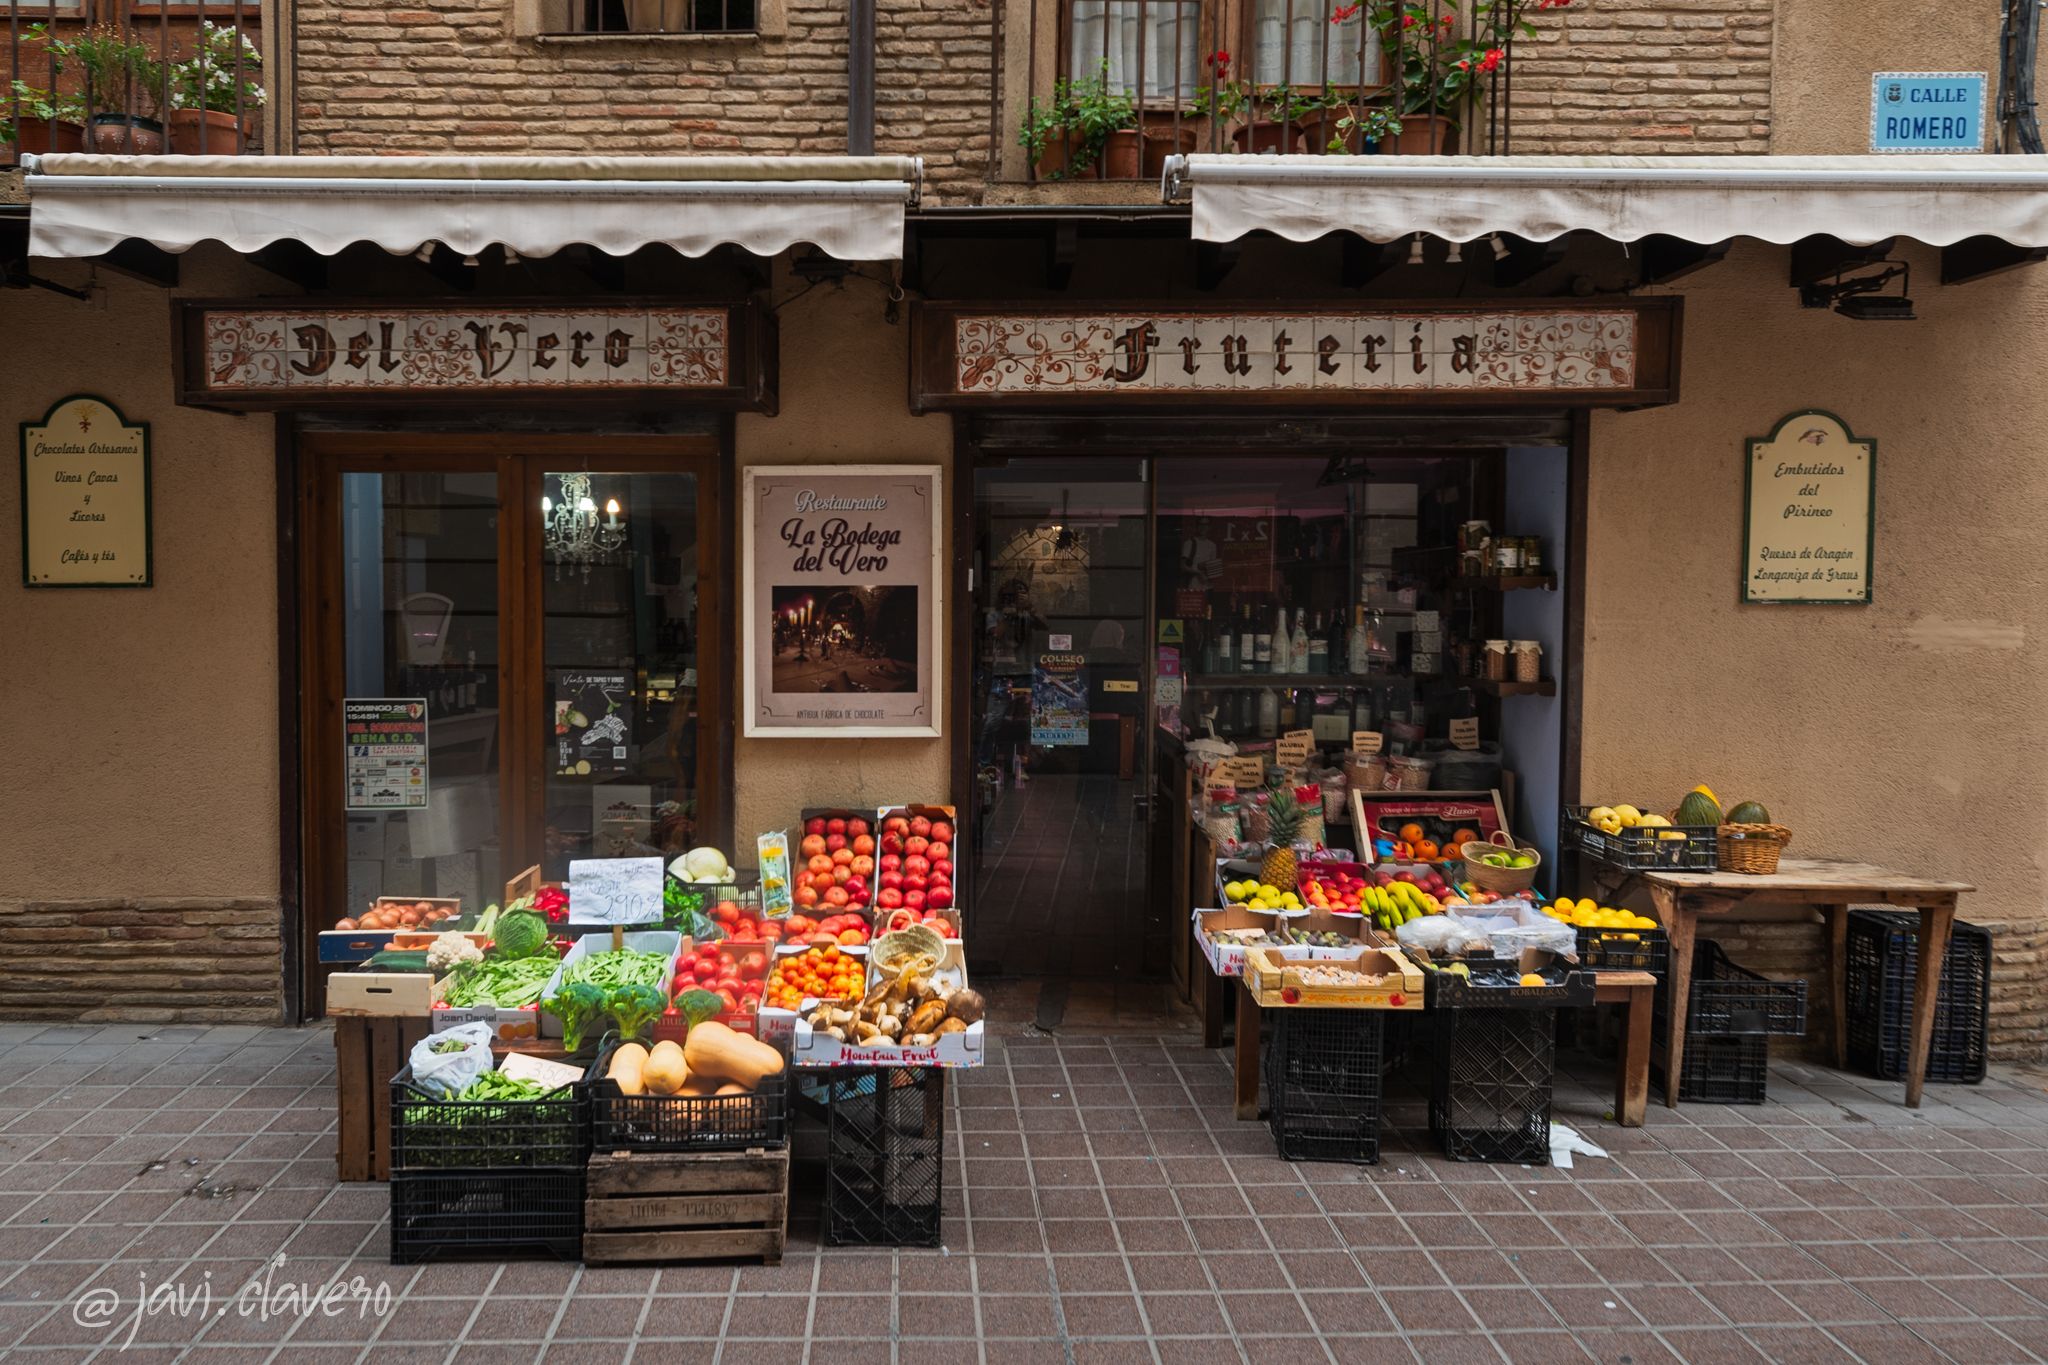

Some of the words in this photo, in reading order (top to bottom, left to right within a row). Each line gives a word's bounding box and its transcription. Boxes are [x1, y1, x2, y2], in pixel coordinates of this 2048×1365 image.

[1910, 88, 1967, 102] CALLE
[1886, 116, 1967, 139] ROMERO
[290, 321, 400, 376] Del
[464, 320, 634, 379] Vero
[1103, 320, 1480, 383] Fruteria
[34, 442, 85, 457] Chocolates
[88, 442, 138, 454] Artesanos
[1774, 462, 1844, 478] Embutidos
[55, 471, 82, 483] Vinos
[87, 471, 118, 485] Cavas
[1798, 484, 1820, 496] del
[795, 489, 887, 512] Restaurante
[69, 510, 105, 522] Licores
[1783, 504, 1833, 519] Pirineo
[781, 518, 815, 548] La
[820, 518, 901, 550] Bodega
[61, 549, 89, 564] Cafés
[92, 552, 99, 564] y
[793, 547, 827, 572] del
[828, 544, 888, 575] Vero
[1760, 546, 1796, 561] Quesos
[1800, 547, 1811, 559] de
[1754, 567, 1808, 583] Longaniza
[1811, 567, 1823, 580] de
[1826, 567, 1858, 582] Graus
[1040, 654, 1085, 665] COLISEO
[346, 704, 393, 712] DOMINGO
[854, 710, 884, 719] CHOCOLATE
[1279, 741, 1305, 749] ALUBIA
[440, 1013, 463, 1023] Joan
[840, 1047, 897, 1062] Mountain
[901, 1047, 938, 1061] Fruit
